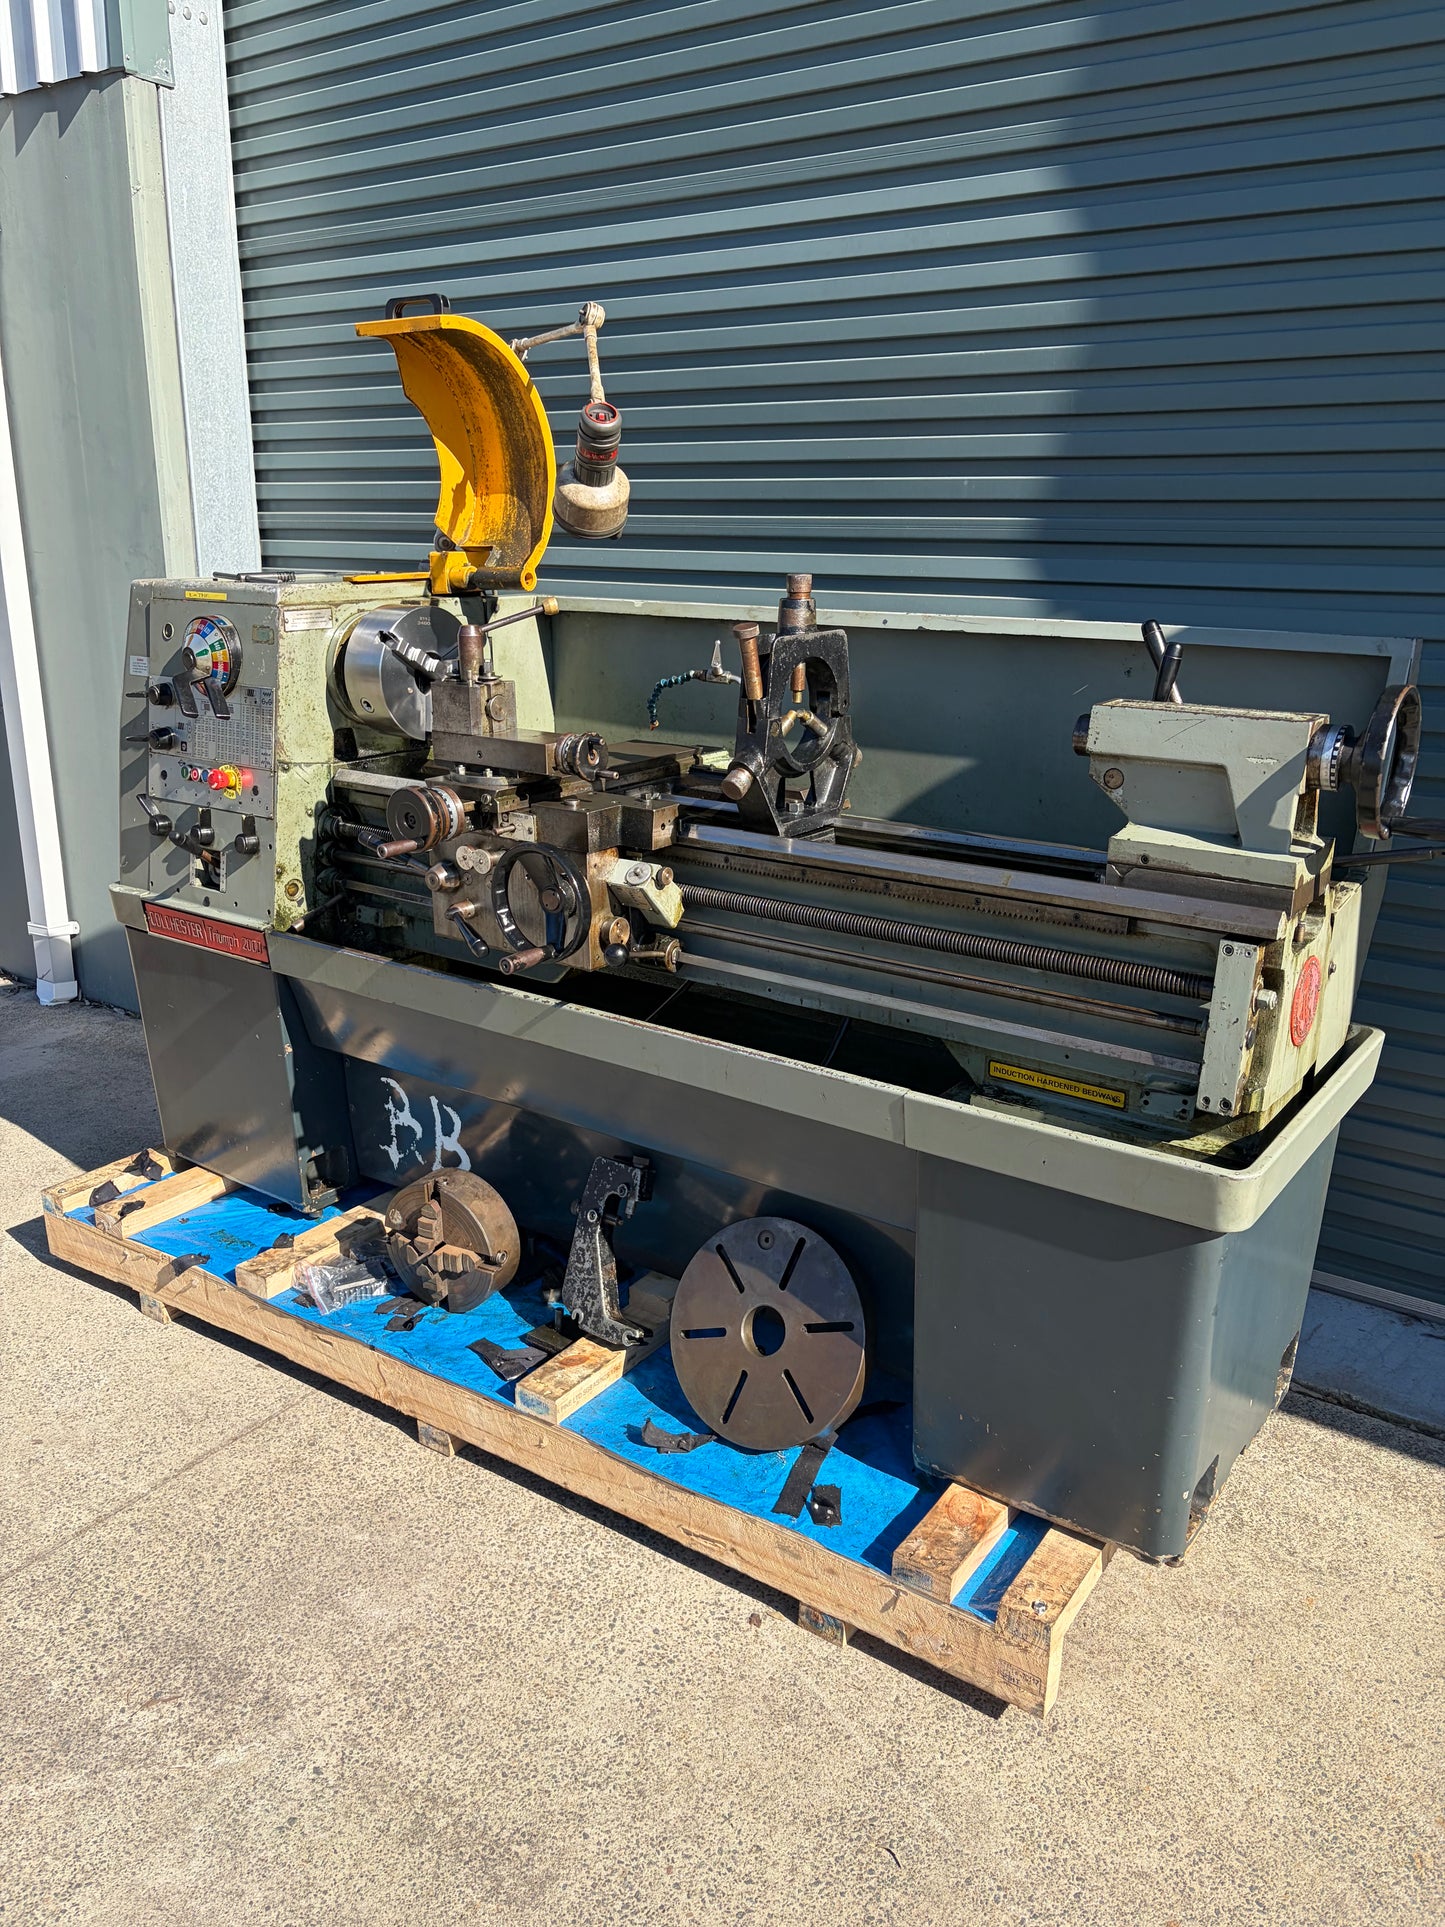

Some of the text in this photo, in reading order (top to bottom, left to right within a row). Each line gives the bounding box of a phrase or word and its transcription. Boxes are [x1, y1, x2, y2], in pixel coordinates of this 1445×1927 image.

[149, 911, 204, 939] COLCHESTER
[206, 926, 240, 950] Triumph
[993, 1066, 1121, 1103] INDUCTION HARDENED BEDWAYS
